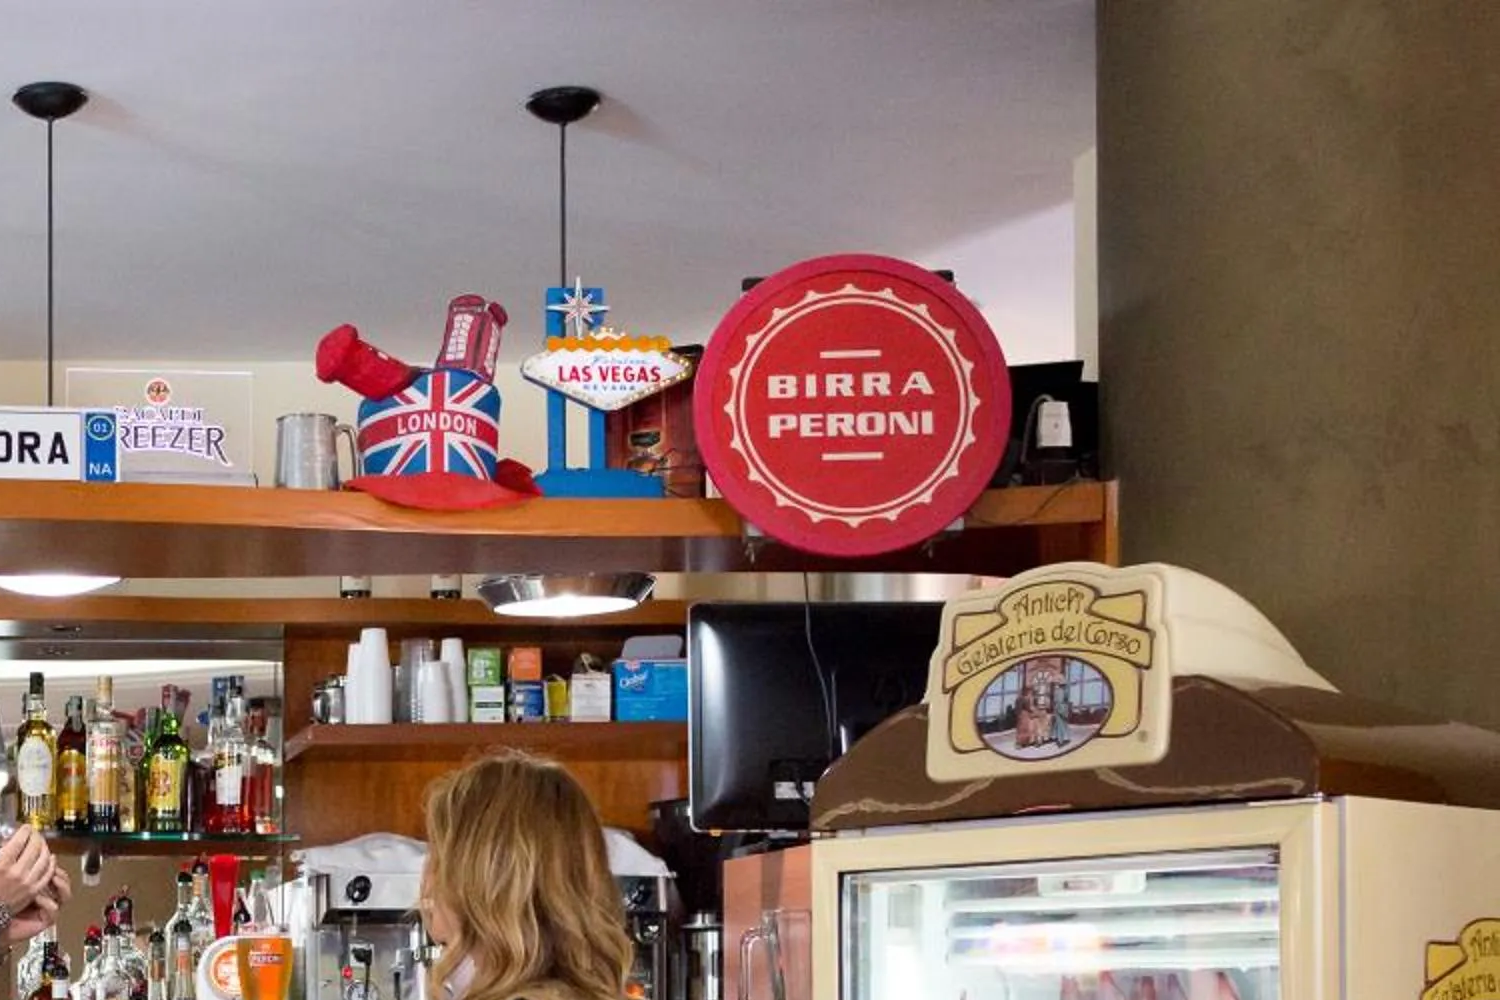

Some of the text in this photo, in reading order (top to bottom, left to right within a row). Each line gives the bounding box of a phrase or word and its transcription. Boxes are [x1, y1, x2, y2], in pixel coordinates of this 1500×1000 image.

[557, 365, 661, 383] LAS VEGAS
[767, 371, 934, 399] BIRRA
[397, 411, 477, 437] LONDON
[768, 410, 933, 438] PERONI
[120, 425, 228, 464] REEZER
[89, 463, 112, 476] NA
[957, 619, 1141, 675] Gelateria del Corso
